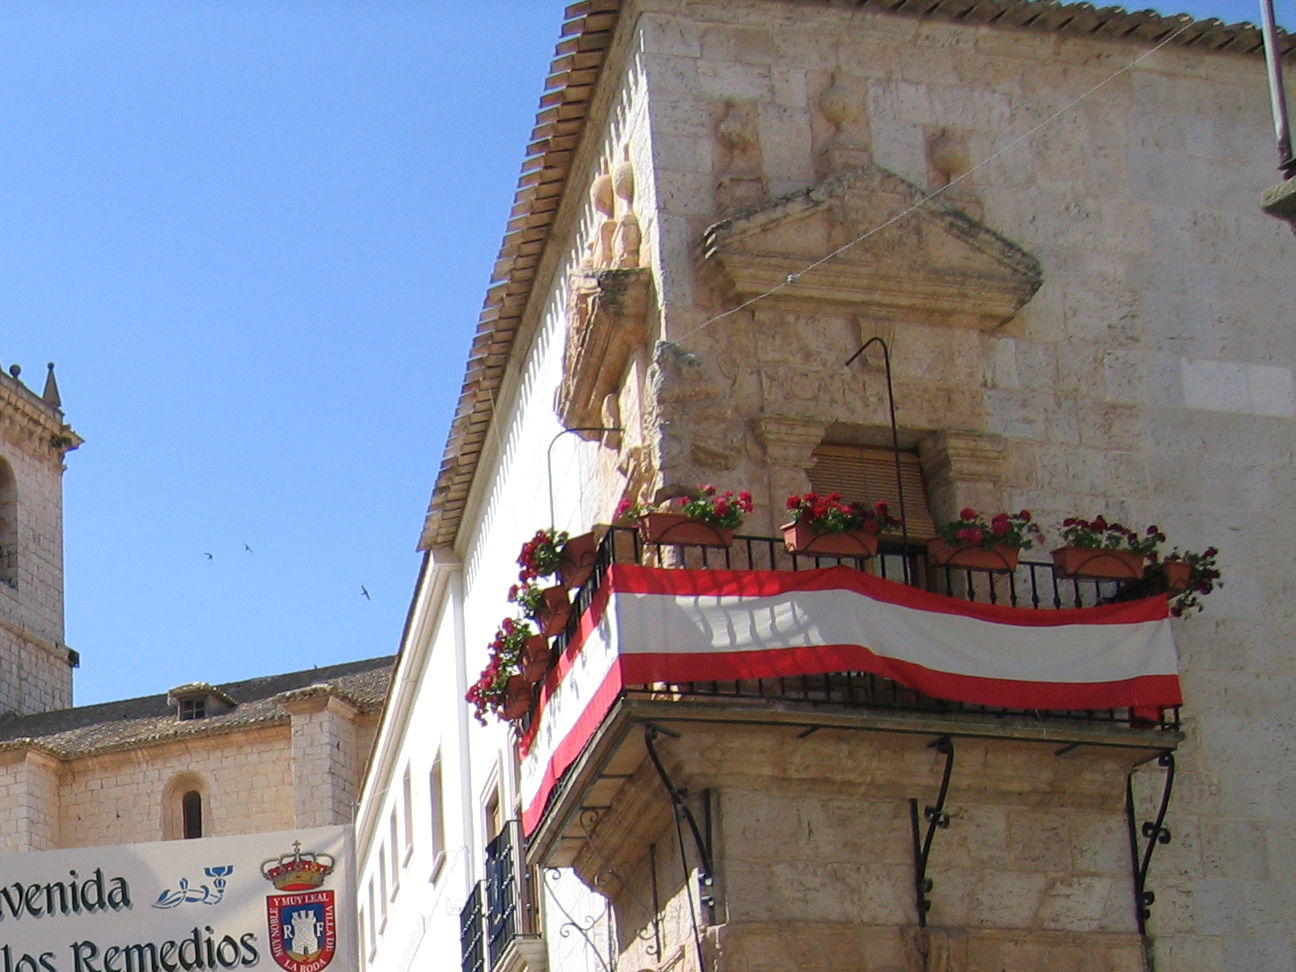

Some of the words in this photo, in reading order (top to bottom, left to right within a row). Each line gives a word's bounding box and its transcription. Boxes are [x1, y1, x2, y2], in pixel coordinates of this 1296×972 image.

[273, 898, 280, 906] Y
[282, 897, 302, 905] MUY
[305, 893, 328, 903] LEAL
[325, 905, 334, 936] VILLA
[284, 925, 292, 938] R
[316, 922, 324, 936] F
[326, 938, 334, 951] DE
[284, 960, 296, 972] LA
[300, 959, 326, 972] RODA
